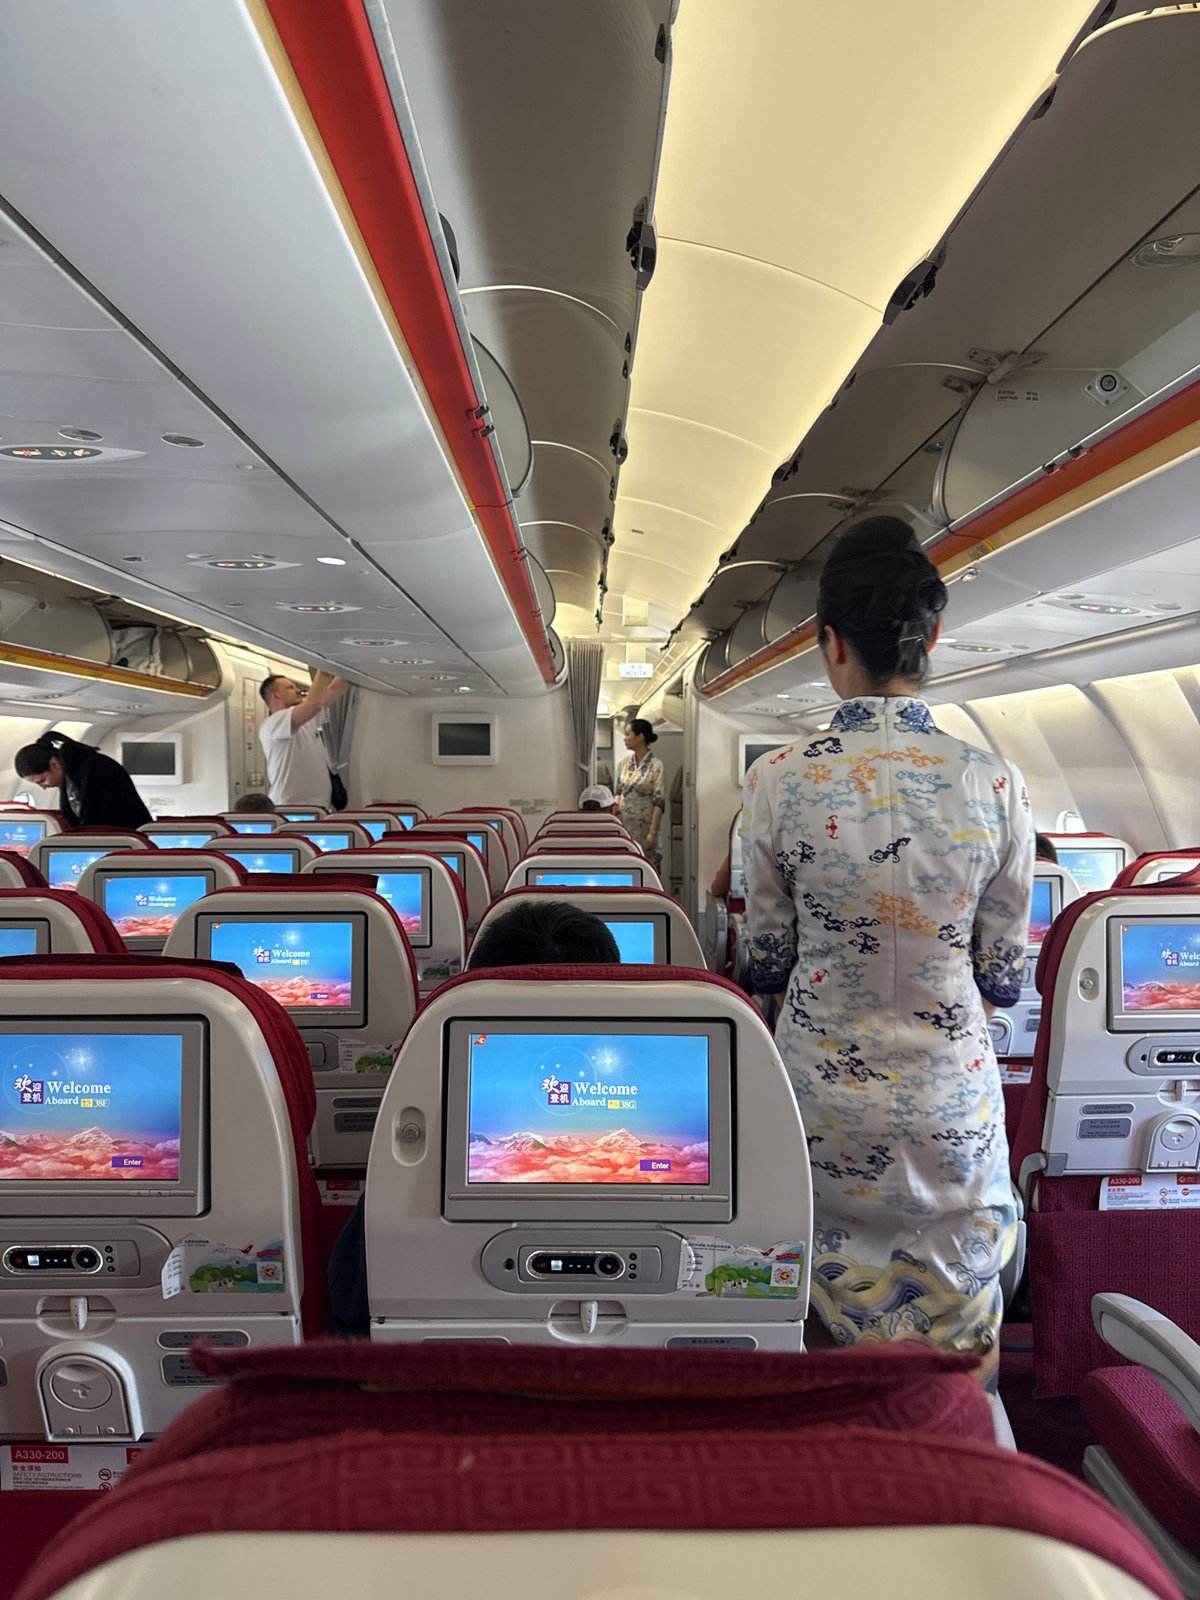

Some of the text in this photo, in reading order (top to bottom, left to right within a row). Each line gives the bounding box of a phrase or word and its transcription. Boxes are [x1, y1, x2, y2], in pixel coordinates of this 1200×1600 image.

[272, 950, 311, 958] Welcome
[47, 1081, 111, 1094] Welcome
[574, 1082, 638, 1095] Welcome
[44, 1096, 79, 1105] Aboard
[571, 1097, 606, 1106] Aboard
[123, 1158, 142, 1166] Enter
[651, 1162, 670, 1170] Enter
[1110, 1177, 1140, 1185] A330-200
[15, 1450, 65, 1460] A330-200
